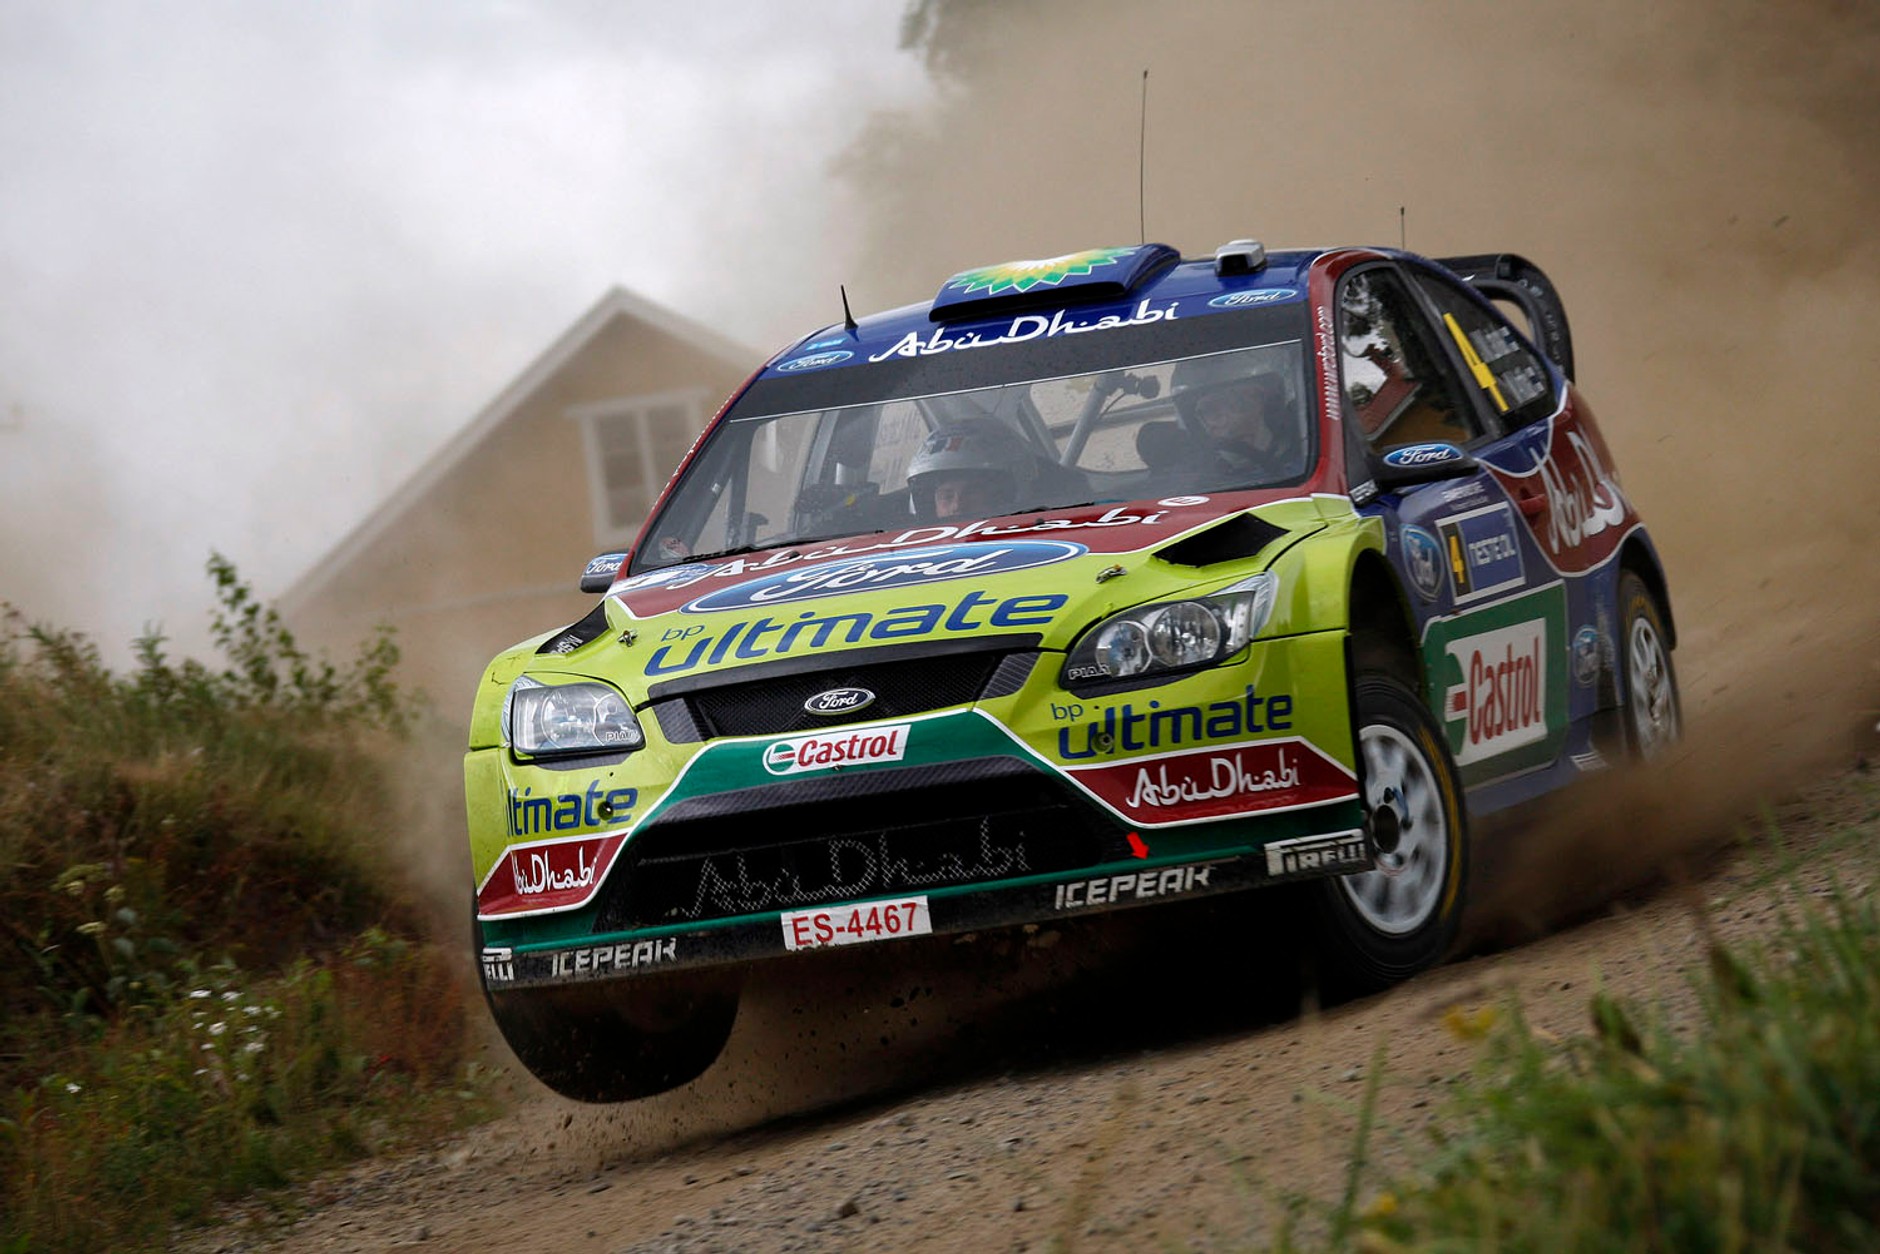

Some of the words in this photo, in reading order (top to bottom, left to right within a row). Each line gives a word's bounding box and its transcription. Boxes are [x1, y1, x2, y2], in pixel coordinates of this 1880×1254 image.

[869, 325, 1006, 362] Abu
[1006, 299, 1180, 341] Dhabi
[1399, 447, 1452, 465] Ford
[666, 543, 888, 590] Abu
[888, 506, 1169, 547] Dhabi
[1449, 535, 1465, 584] 4
[750, 549, 1013, 601] Ford
[643, 590, 1069, 677] ultimate
[661, 625, 705, 642] bp
[819, 691, 859, 708] Ford
[1051, 702, 1084, 722] bp
[1469, 635, 1541, 746] Castrol
[1058, 684, 1293, 760] ultimate
[798, 729, 898, 768] Castrol
[1126, 764, 1212, 808] Abu
[1210, 748, 1300, 798] Dhabi
[507, 780, 639, 836] ltimate
[1264, 828, 1365, 877] PIRELLI
[1055, 865, 1213, 910] ICEPEAK
[791, 901, 917, 947] ES-4467
[551, 937, 679, 978] ICEPEAK
